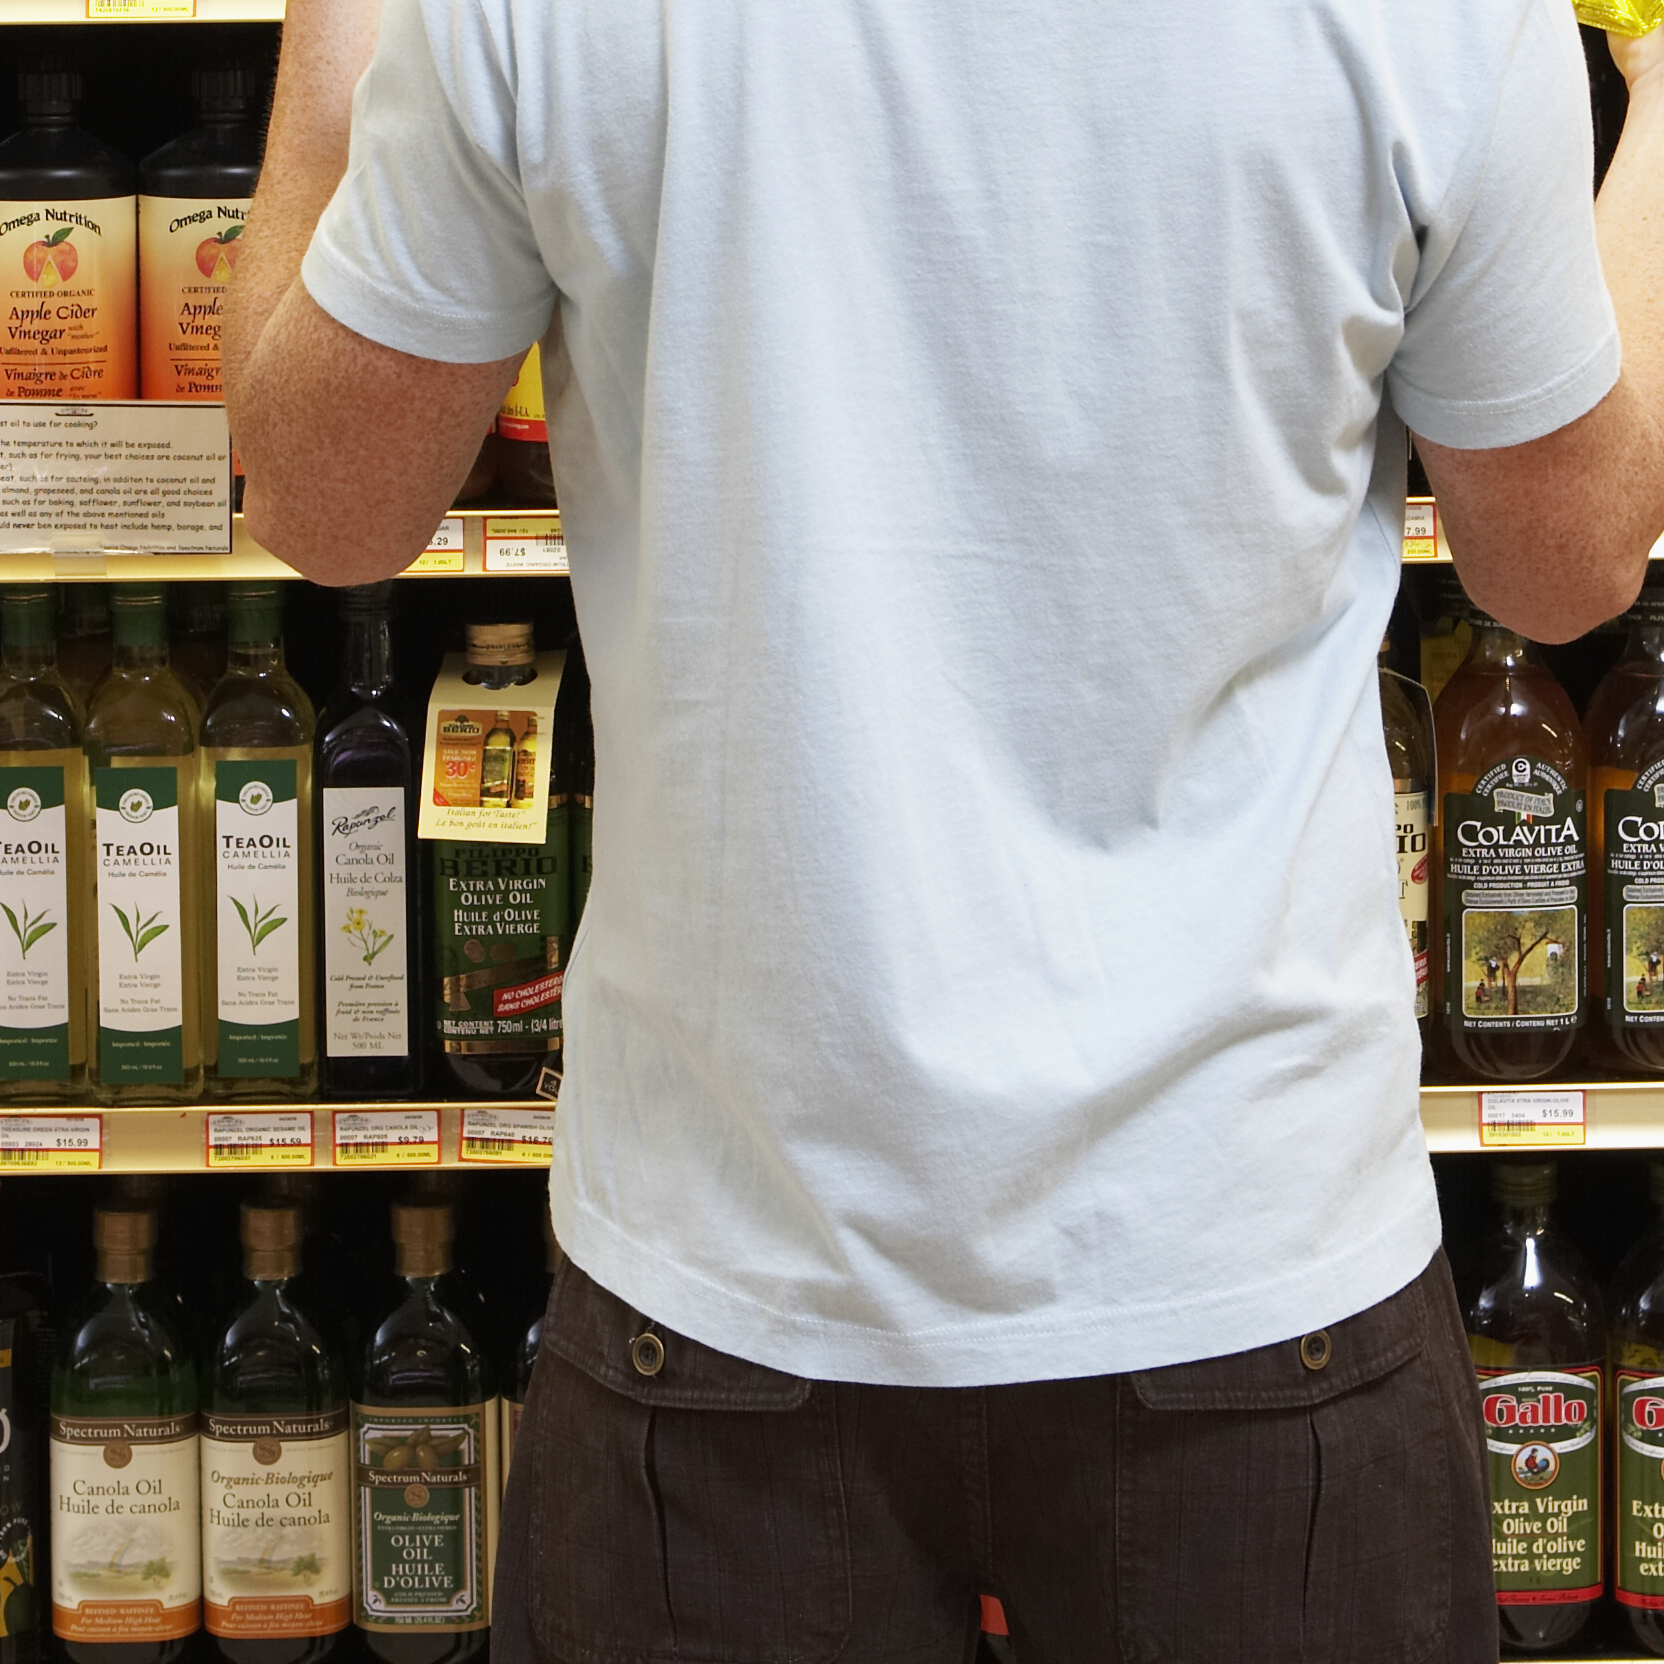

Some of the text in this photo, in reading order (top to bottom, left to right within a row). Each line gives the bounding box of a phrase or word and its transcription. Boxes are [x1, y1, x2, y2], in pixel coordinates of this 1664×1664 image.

[9, 419, 19, 428] oil
[23, 419, 31, 428] to
[33, 420, 46, 428] use
[49, 419, 60, 428] for
[64, 419, 98, 431] cooking?
[1457, 818, 1580, 846] COLAVITA
[102, 858, 172, 867] CAMELLIA
[335, 853, 395, 866] Canola Oil
[1542, 1108, 1574, 1119] $15.99
[56, 1137, 89, 1149] $15.99
[59, 1422, 181, 1440] Spectrum Naturals
[73, 1478, 163, 1497] Canola Oil
